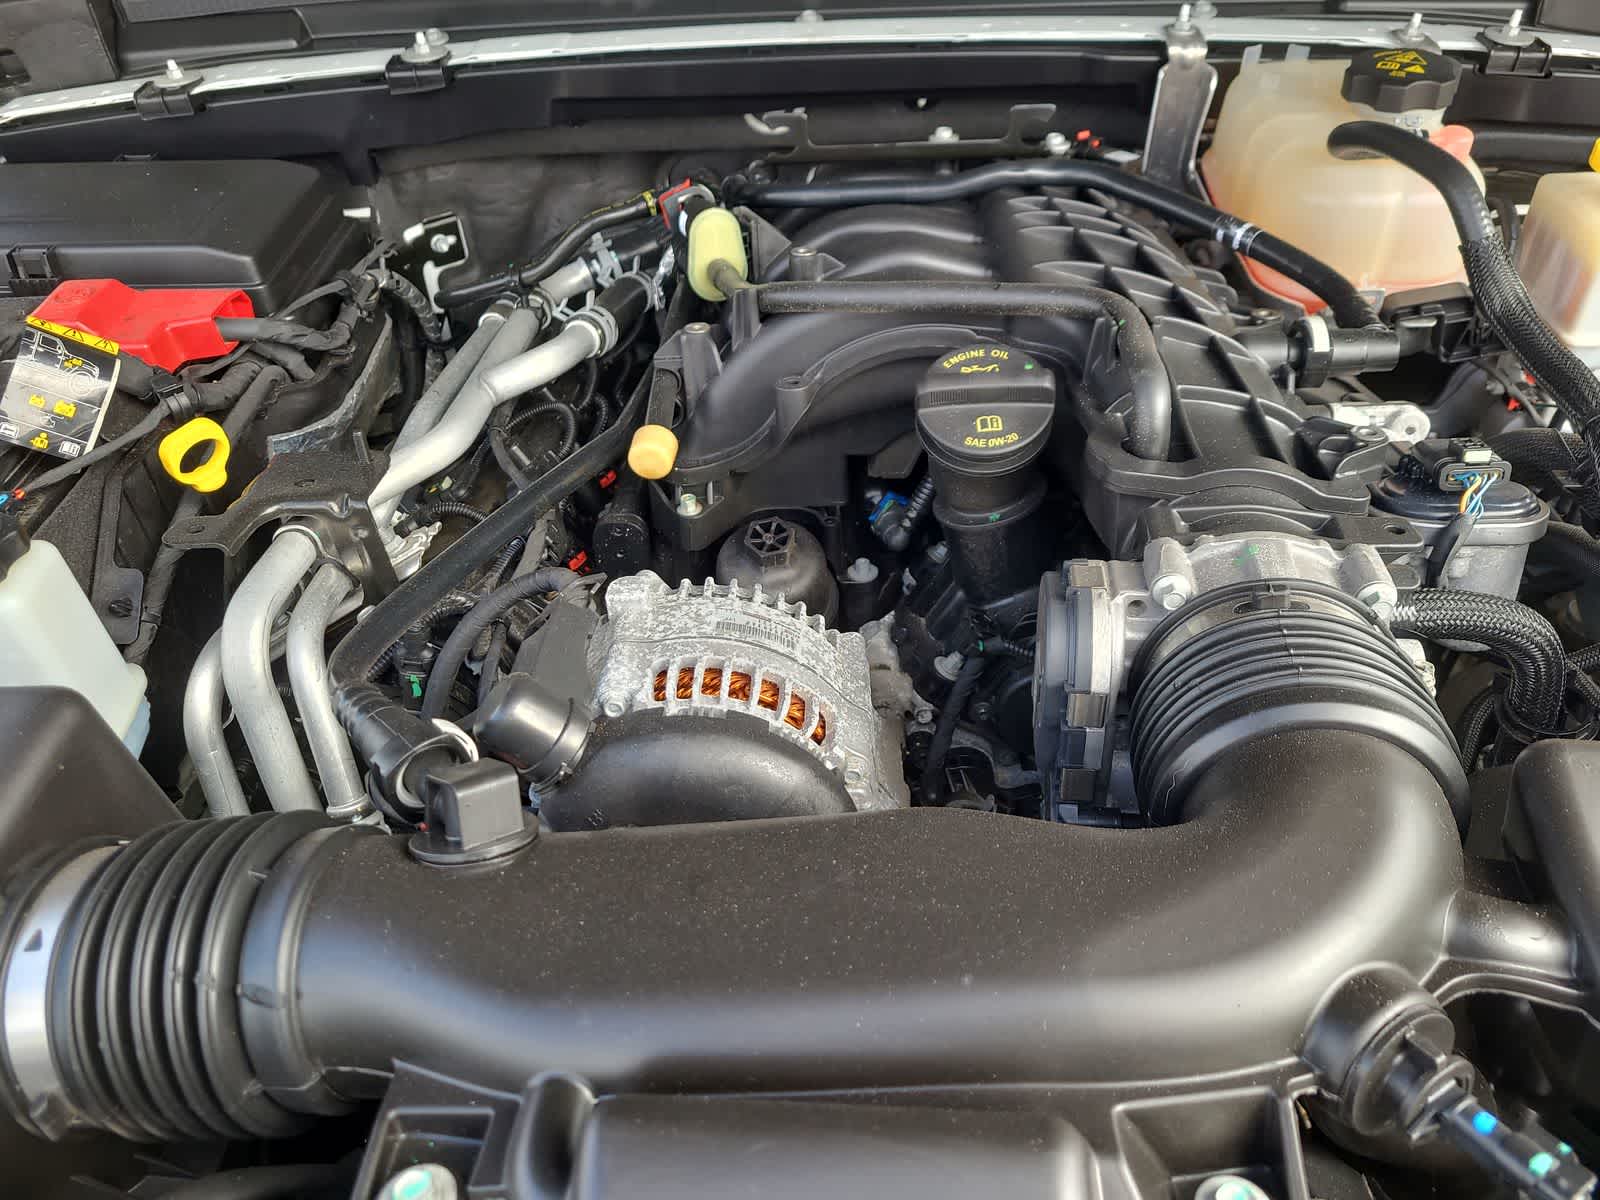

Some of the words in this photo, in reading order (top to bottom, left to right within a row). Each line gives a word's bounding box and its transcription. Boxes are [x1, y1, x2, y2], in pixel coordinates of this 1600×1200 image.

[943, 348, 985, 368] ENGINE
[991, 349, 1009, 360] OIL
[964, 436, 987, 447] SAE
[988, 432, 1019, 447] 0W-20
